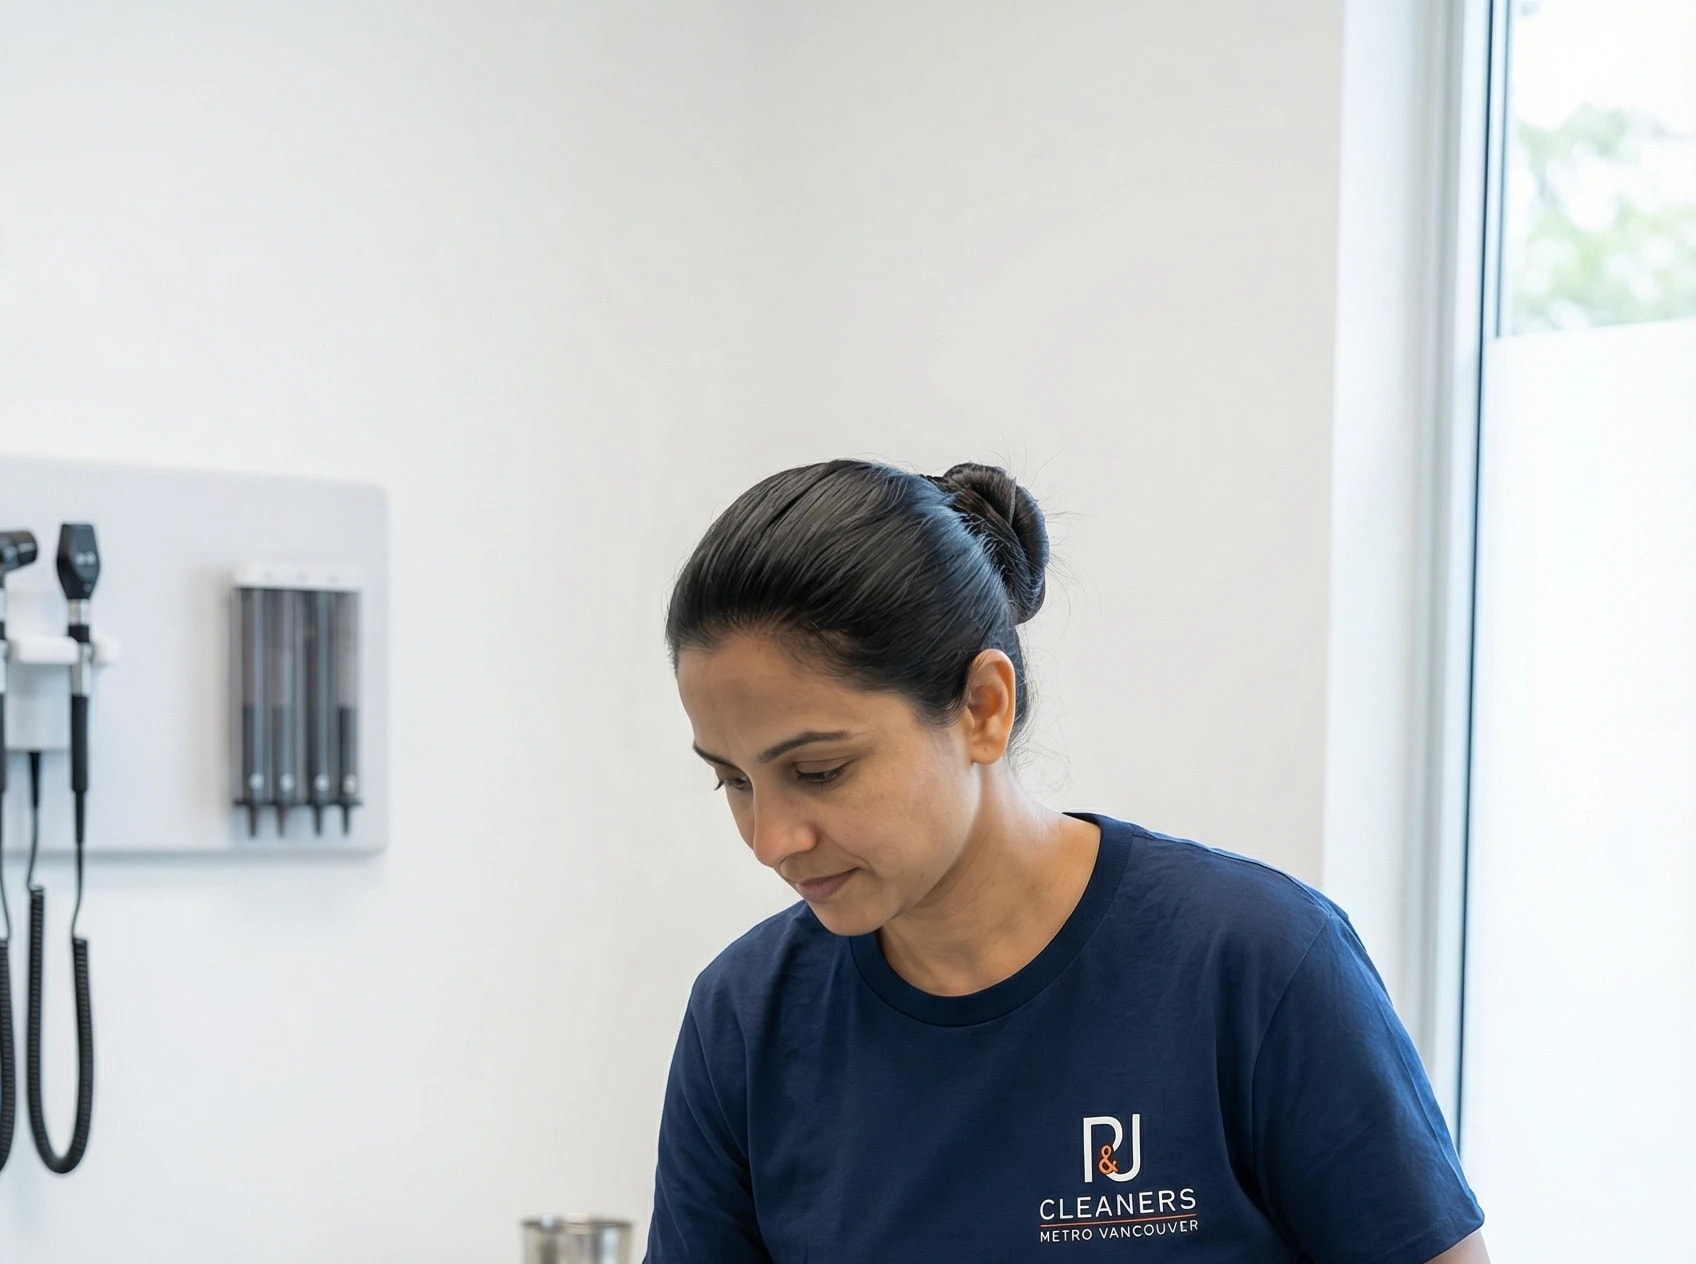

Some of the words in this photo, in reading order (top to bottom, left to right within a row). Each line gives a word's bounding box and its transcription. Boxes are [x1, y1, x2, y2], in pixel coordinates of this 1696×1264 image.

[1039, 1188, 1196, 1220] CLEANERS
[1040, 1228, 1093, 1242] METRO
[1098, 1219, 1198, 1239] VANCOUVER
